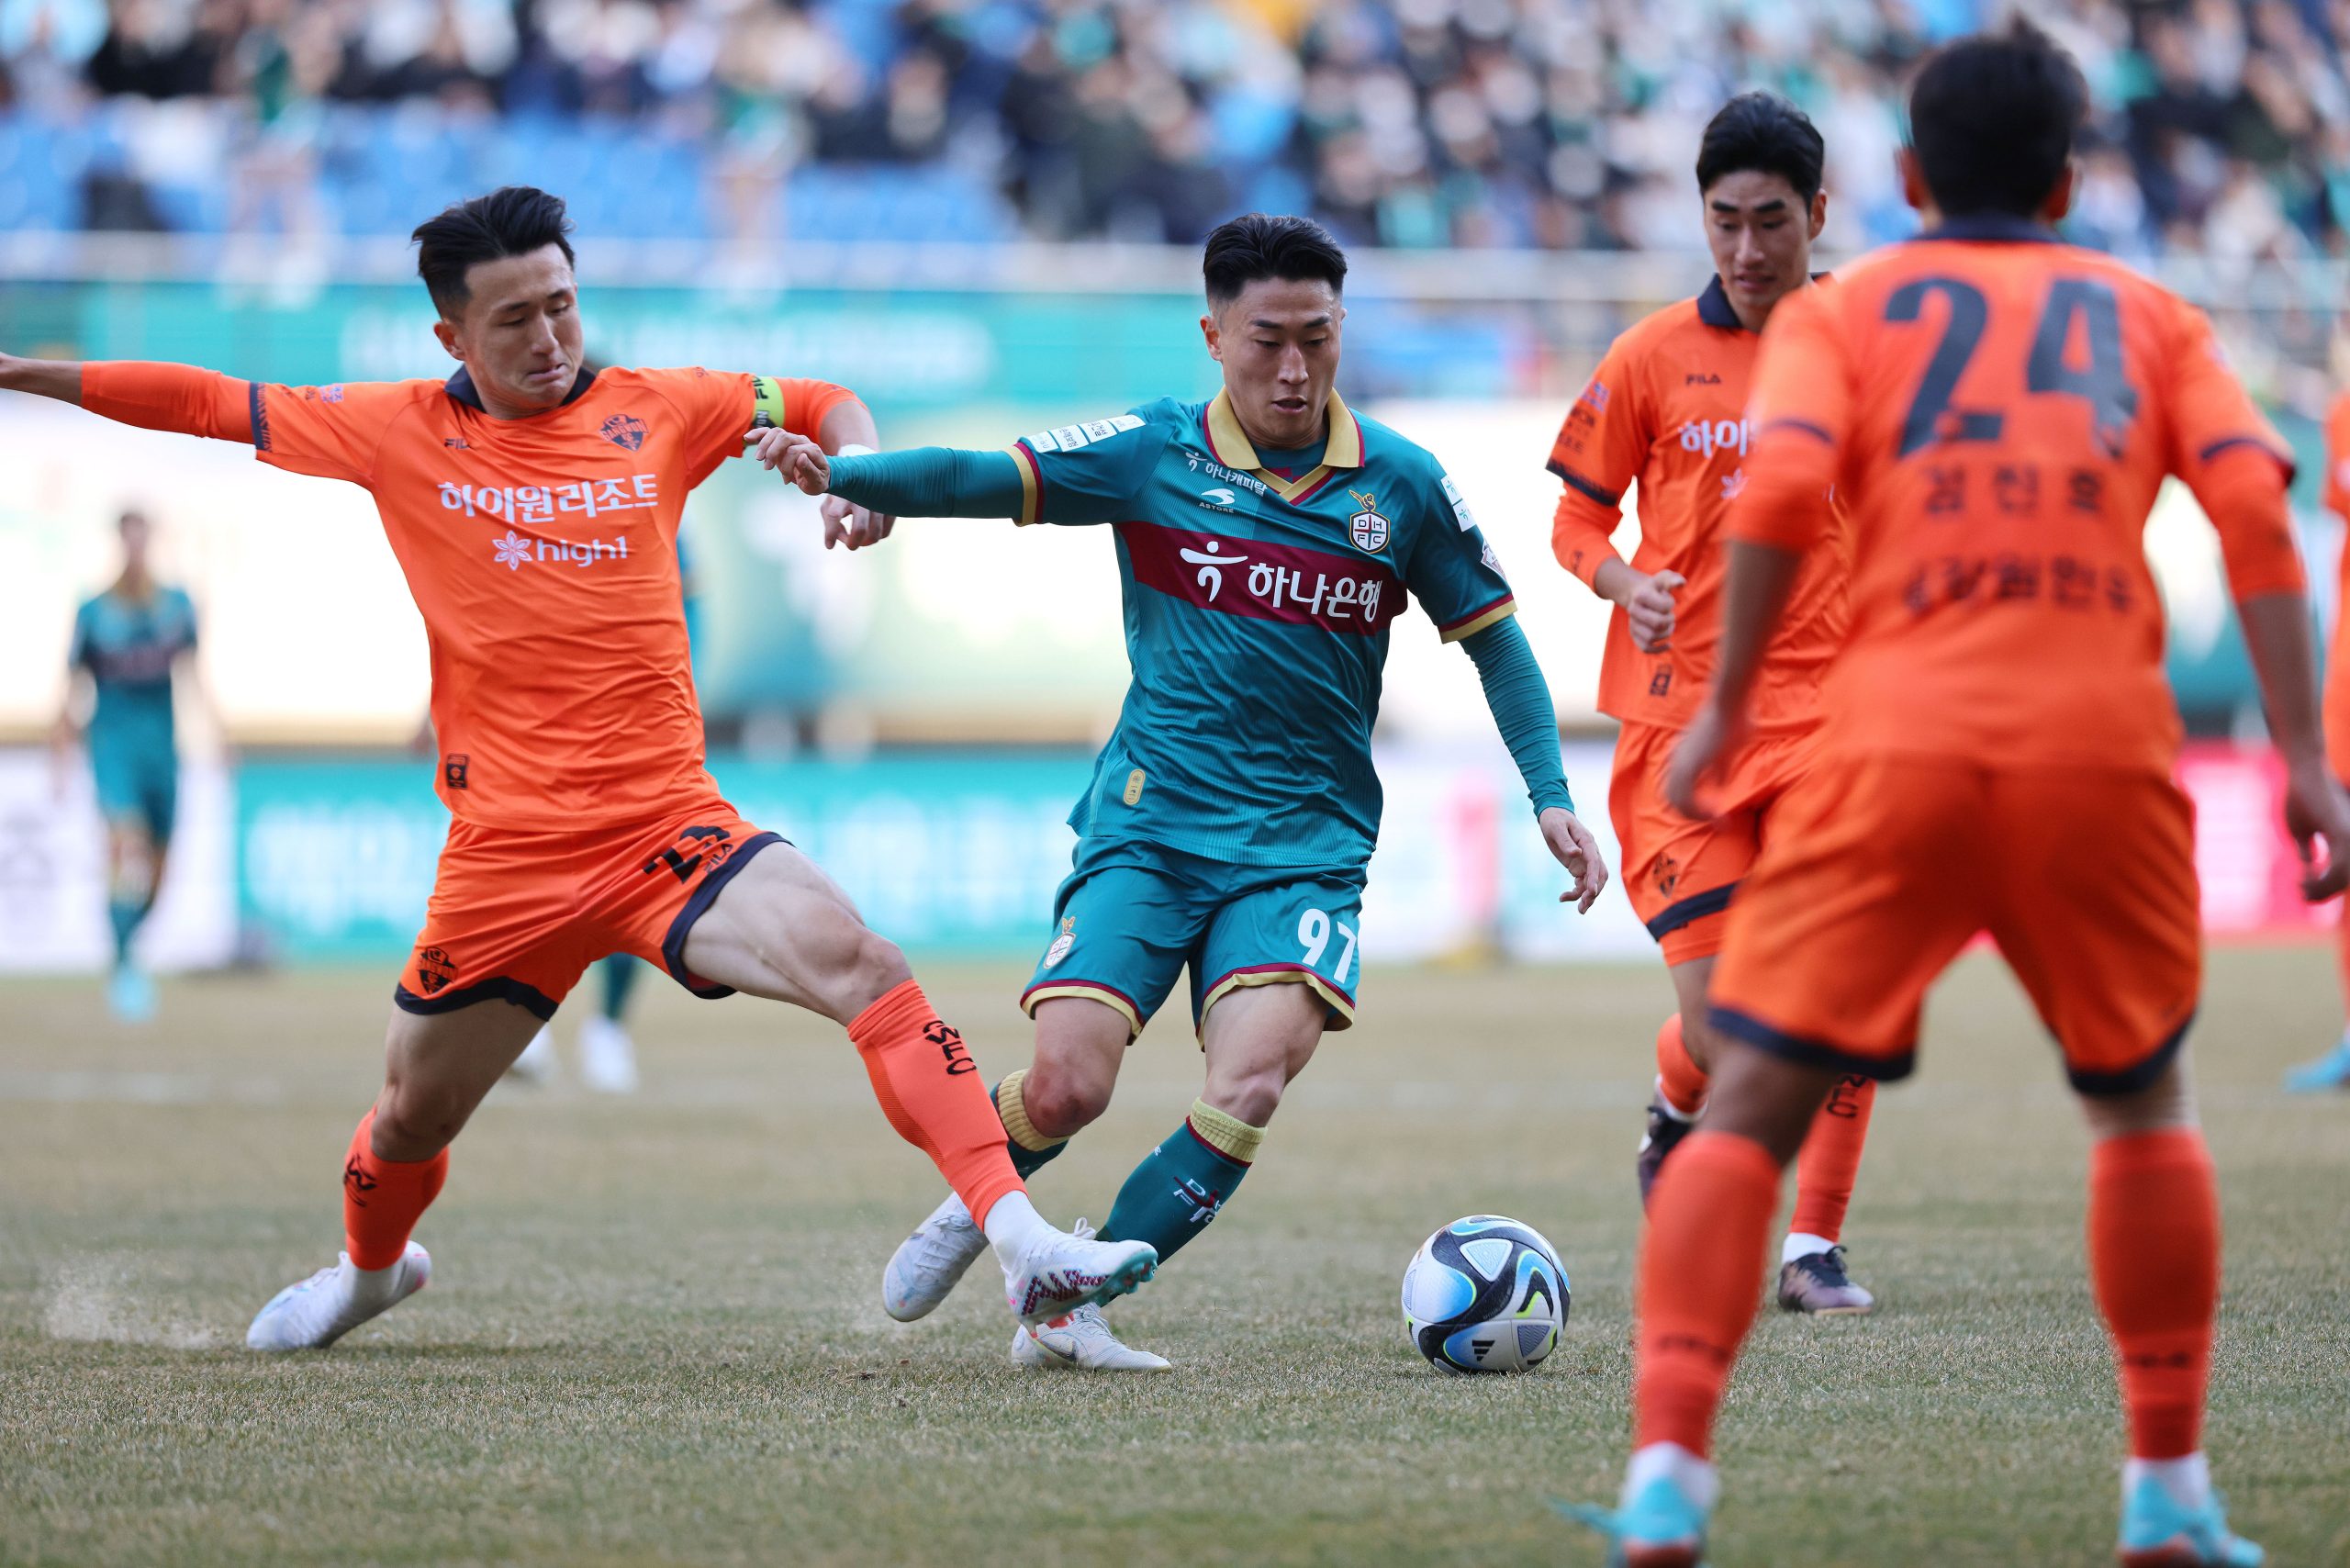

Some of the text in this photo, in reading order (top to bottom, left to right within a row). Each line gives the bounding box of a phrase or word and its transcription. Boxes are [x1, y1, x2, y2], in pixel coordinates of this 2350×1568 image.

[1685, 373, 1721, 386] FILA
[1885, 274, 2138, 460] 24
[437, 474, 659, 524] 하이원리조트
[1205, 462, 1268, 497] 하나캐피탈
[1199, 501, 1235, 514] ASTORE
[537, 536, 628, 567] high1
[1248, 562, 1383, 622] 하나은행
[1297, 908, 1358, 984] 97
